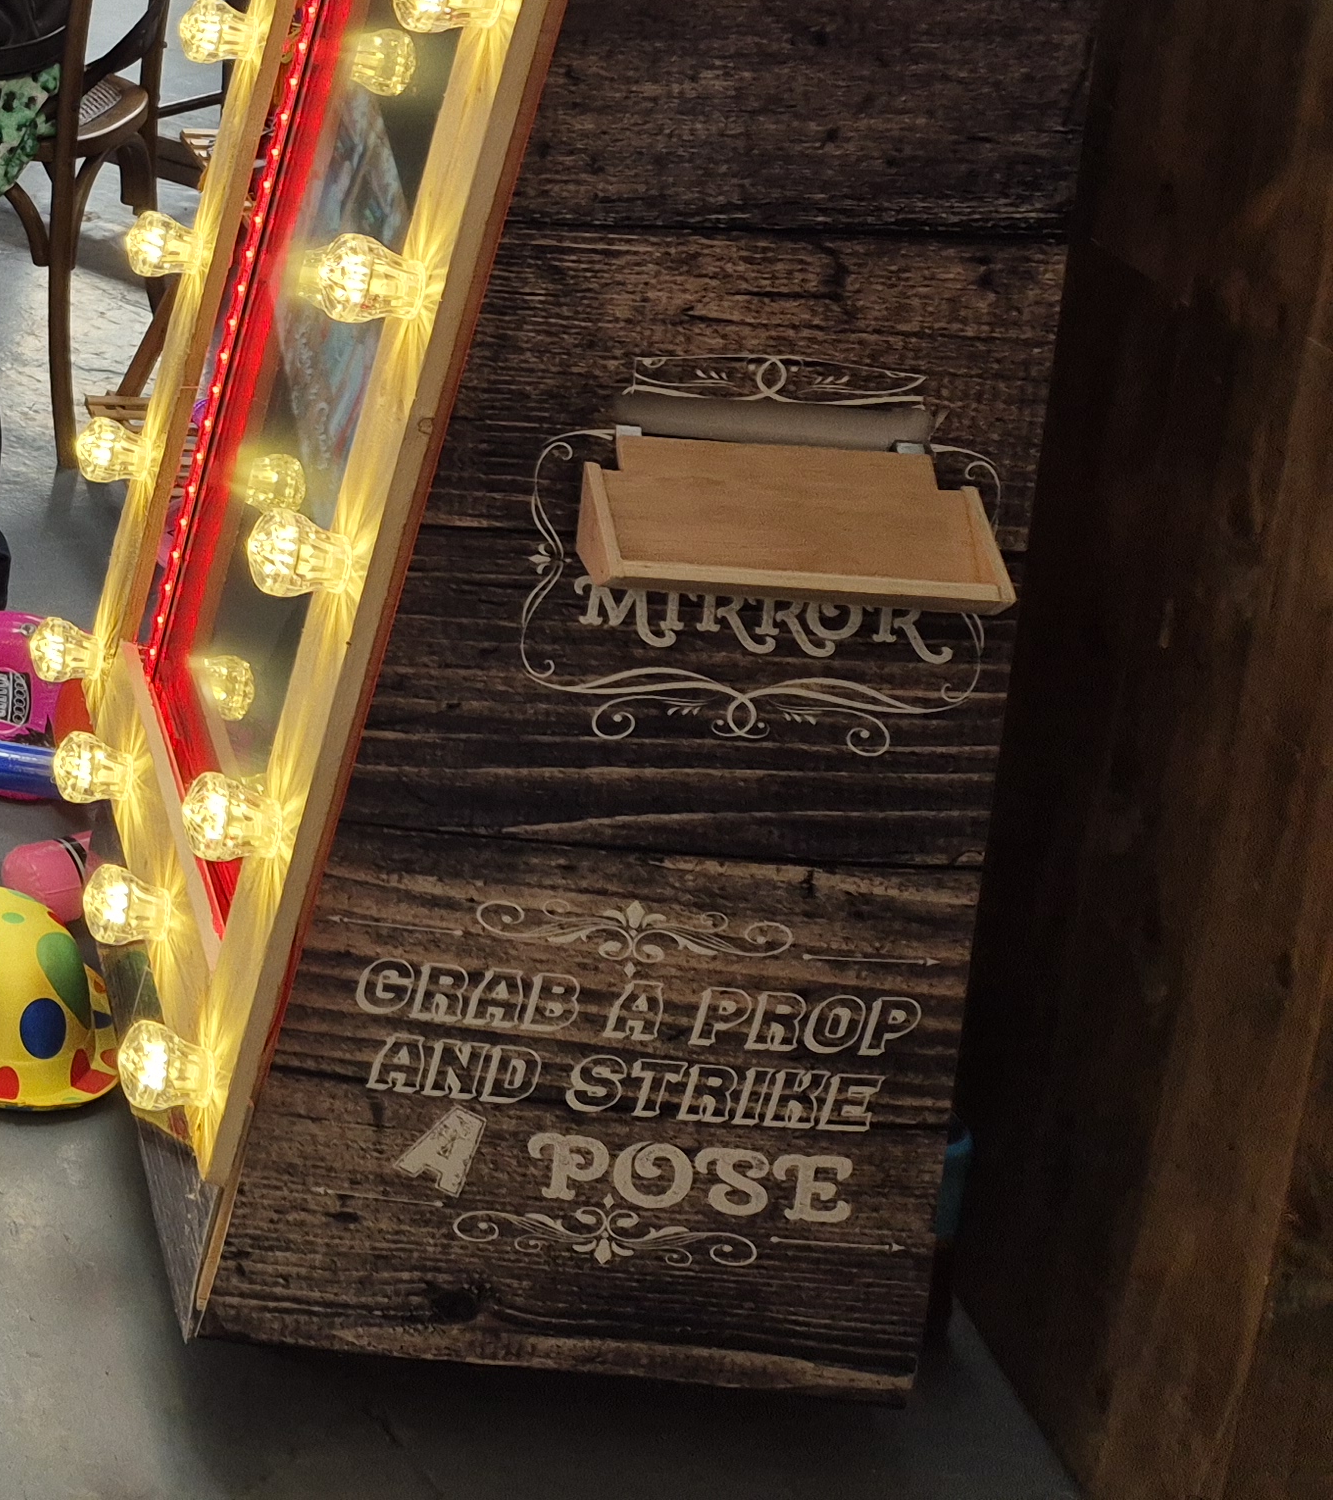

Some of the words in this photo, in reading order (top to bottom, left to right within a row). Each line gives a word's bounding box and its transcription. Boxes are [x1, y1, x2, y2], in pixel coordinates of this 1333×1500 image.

[355, 958, 581, 1032] GRAB
[603, 981, 665, 1041] A
[688, 987, 922, 1056] PROP
[365, 1034, 542, 1103] AND
[565, 1055, 886, 1132] STRIKE
[393, 1105, 487, 1198] A
[527, 1131, 854, 1223] POSE
